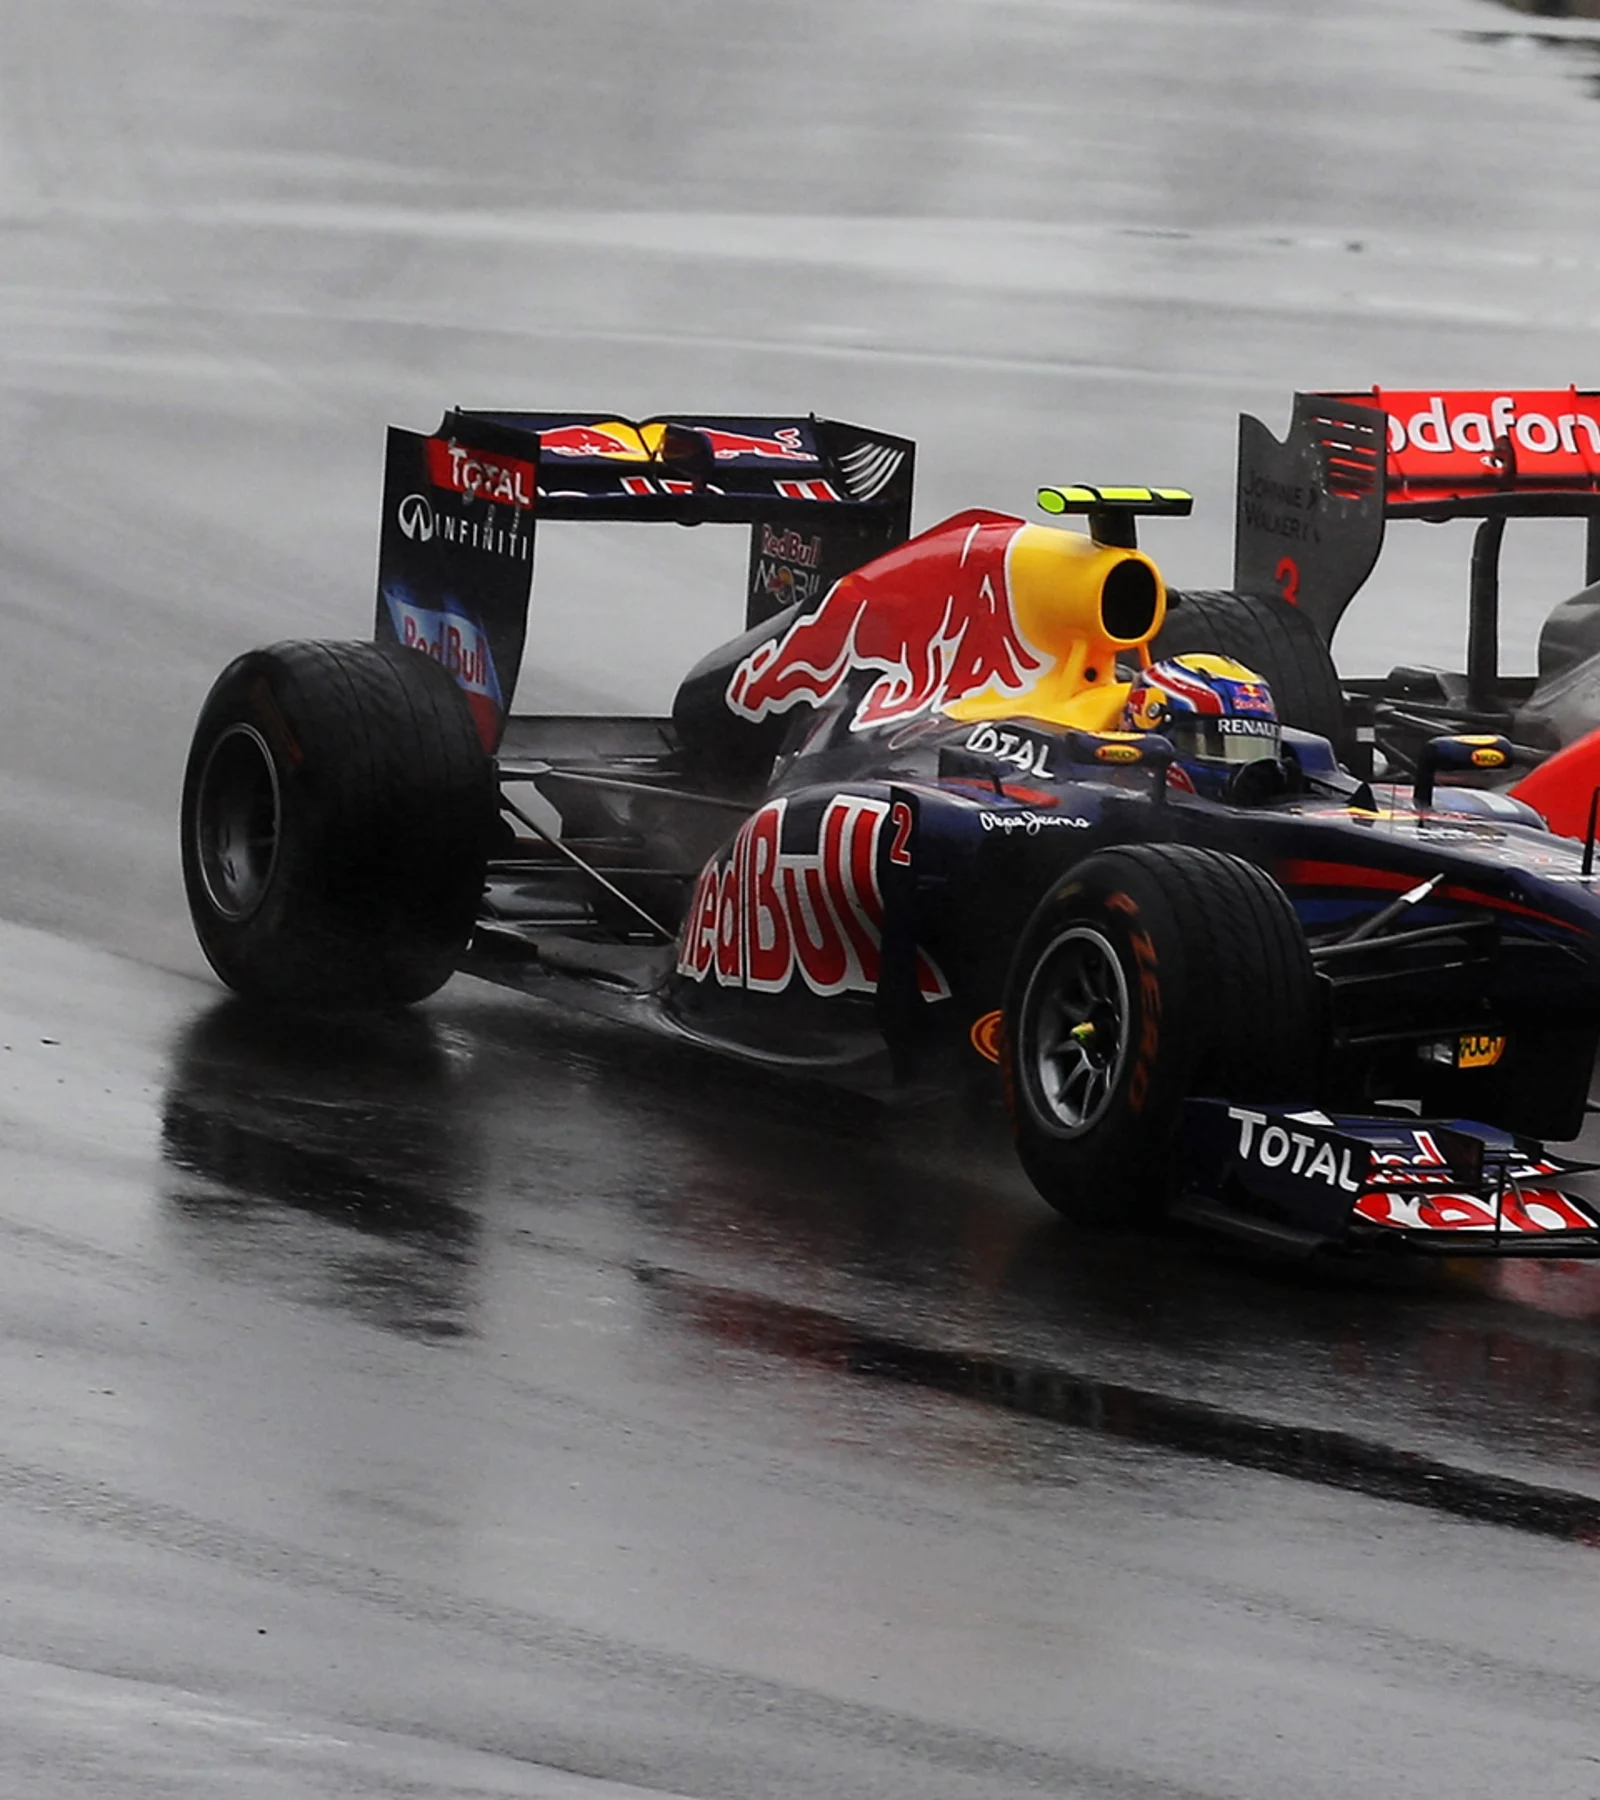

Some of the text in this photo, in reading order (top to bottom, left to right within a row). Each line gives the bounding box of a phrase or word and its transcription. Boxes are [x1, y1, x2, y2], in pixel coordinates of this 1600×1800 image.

[447, 446, 530, 504] TOTAL
[435, 512, 527, 560] INFINITI
[889, 801, 914, 867] 2
[1227, 1106, 1360, 1192] TOTAL
